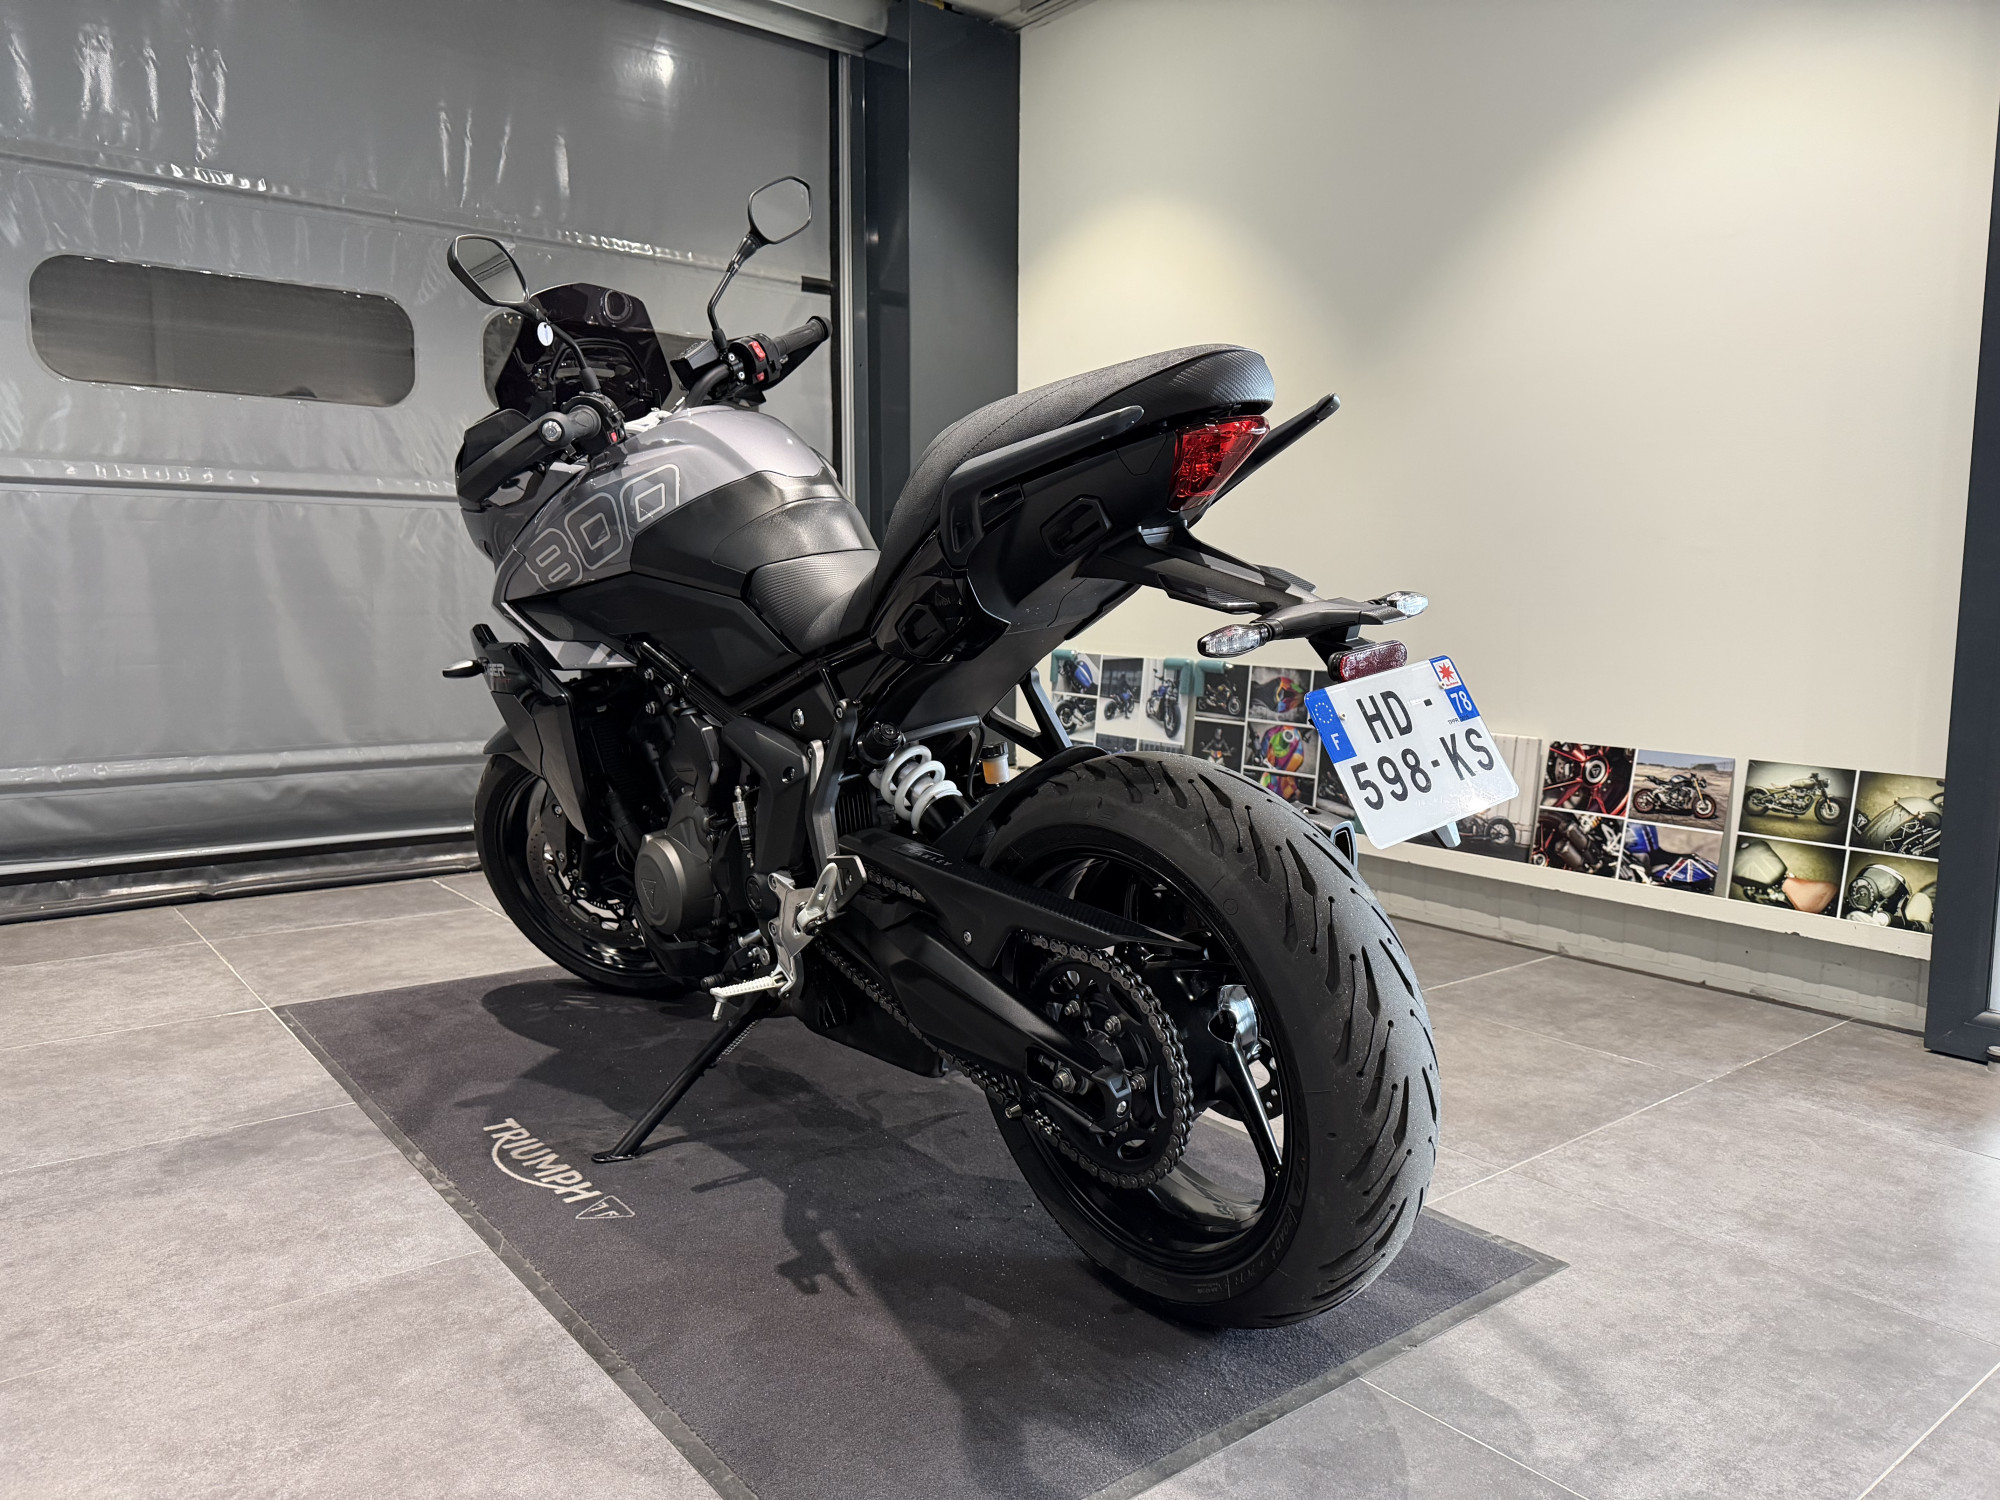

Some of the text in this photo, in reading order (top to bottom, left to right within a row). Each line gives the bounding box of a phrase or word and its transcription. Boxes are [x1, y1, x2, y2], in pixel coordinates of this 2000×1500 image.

[524, 463, 681, 592] 800
[1330, 733, 1341, 751] F
[1450, 690, 1473, 714] 78
[1350, 727, 1495, 811] 598-KS
[483, 1117, 603, 1204] TRIUMPH
